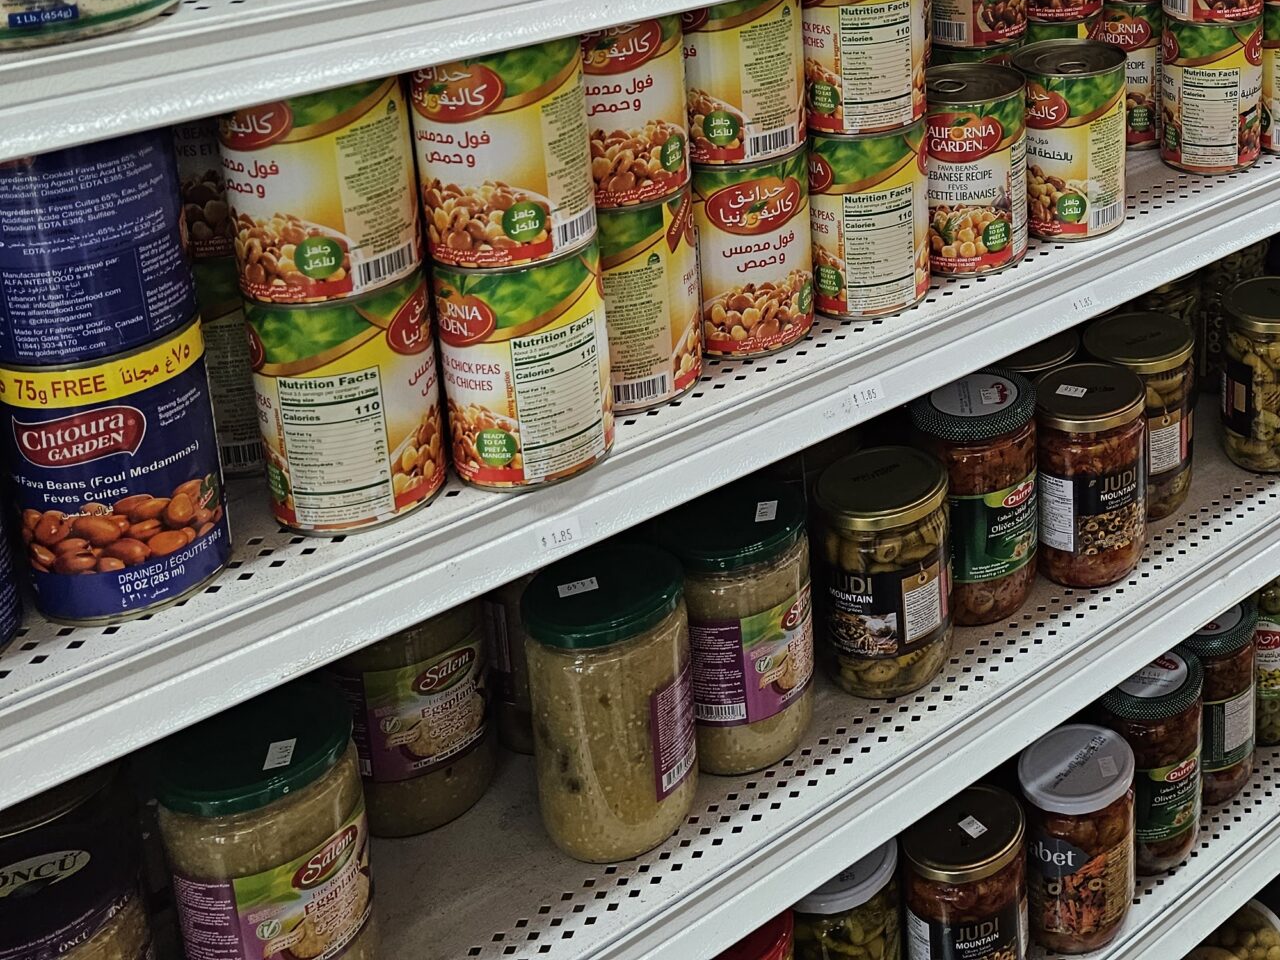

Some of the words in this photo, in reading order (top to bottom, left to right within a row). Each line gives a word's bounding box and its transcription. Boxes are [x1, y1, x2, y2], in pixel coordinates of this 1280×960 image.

[841, 6, 885, 17] Nutrition
[888, 0, 910, 13] Facts
[841, 35, 874, 43] Calories
[895, 27, 910, 36] 110
[1224, 90, 1239, 98] 150
[458, 131, 490, 149] فول
[931, 139, 986, 153] GARDEN
[955, 163, 978, 172] BEANS
[967, 169, 993, 181] RECIPE
[844, 191, 889, 204] Nutrition
[890, 185, 912, 198] Facts
[955, 187, 996, 200] LIBANAISE
[898, 211, 912, 221] 110
[845, 222, 876, 230] Calories
[773, 231, 796, 248] فول
[722, 241, 770, 258] مدمس
[513, 328, 567, 351] Nutrition
[569, 315, 594, 338] Facts
[581, 344, 596, 360] 110
[453, 361, 473, 374] CHICK
[476, 362, 500, 375] PEAS
[516, 365, 555, 381] Calories
[279, 377, 335, 390] Nutrition
[339, 370, 377, 387] Facts
[456, 377, 493, 391] CHICHES
[14, 379, 48, 404] 75g
[51, 375, 107, 398] FREE
[355, 401, 380, 416] 110
[283, 413, 320, 423] Calories
[22, 411, 124, 451] Chtoura
[47, 430, 125, 462] GARDEN
[21, 477, 44, 489] Fava
[46, 478, 87, 490] Beans
[129, 439, 200, 477] Medammas)
[83, 486, 128, 503] Cuites
[1100, 482, 1137, 502] MOUNTAIN
[551, 528, 573, 545] 1.85
[118, 565, 162, 585] DRAINED
[120, 583, 131, 594] 10
[134, 578, 149, 591] OZ
[150, 571, 170, 587] (283
[302, 830, 355, 885] Salem
[1029, 839, 1077, 869] abet
[955, 931, 999, 951] MOUNTAIN
